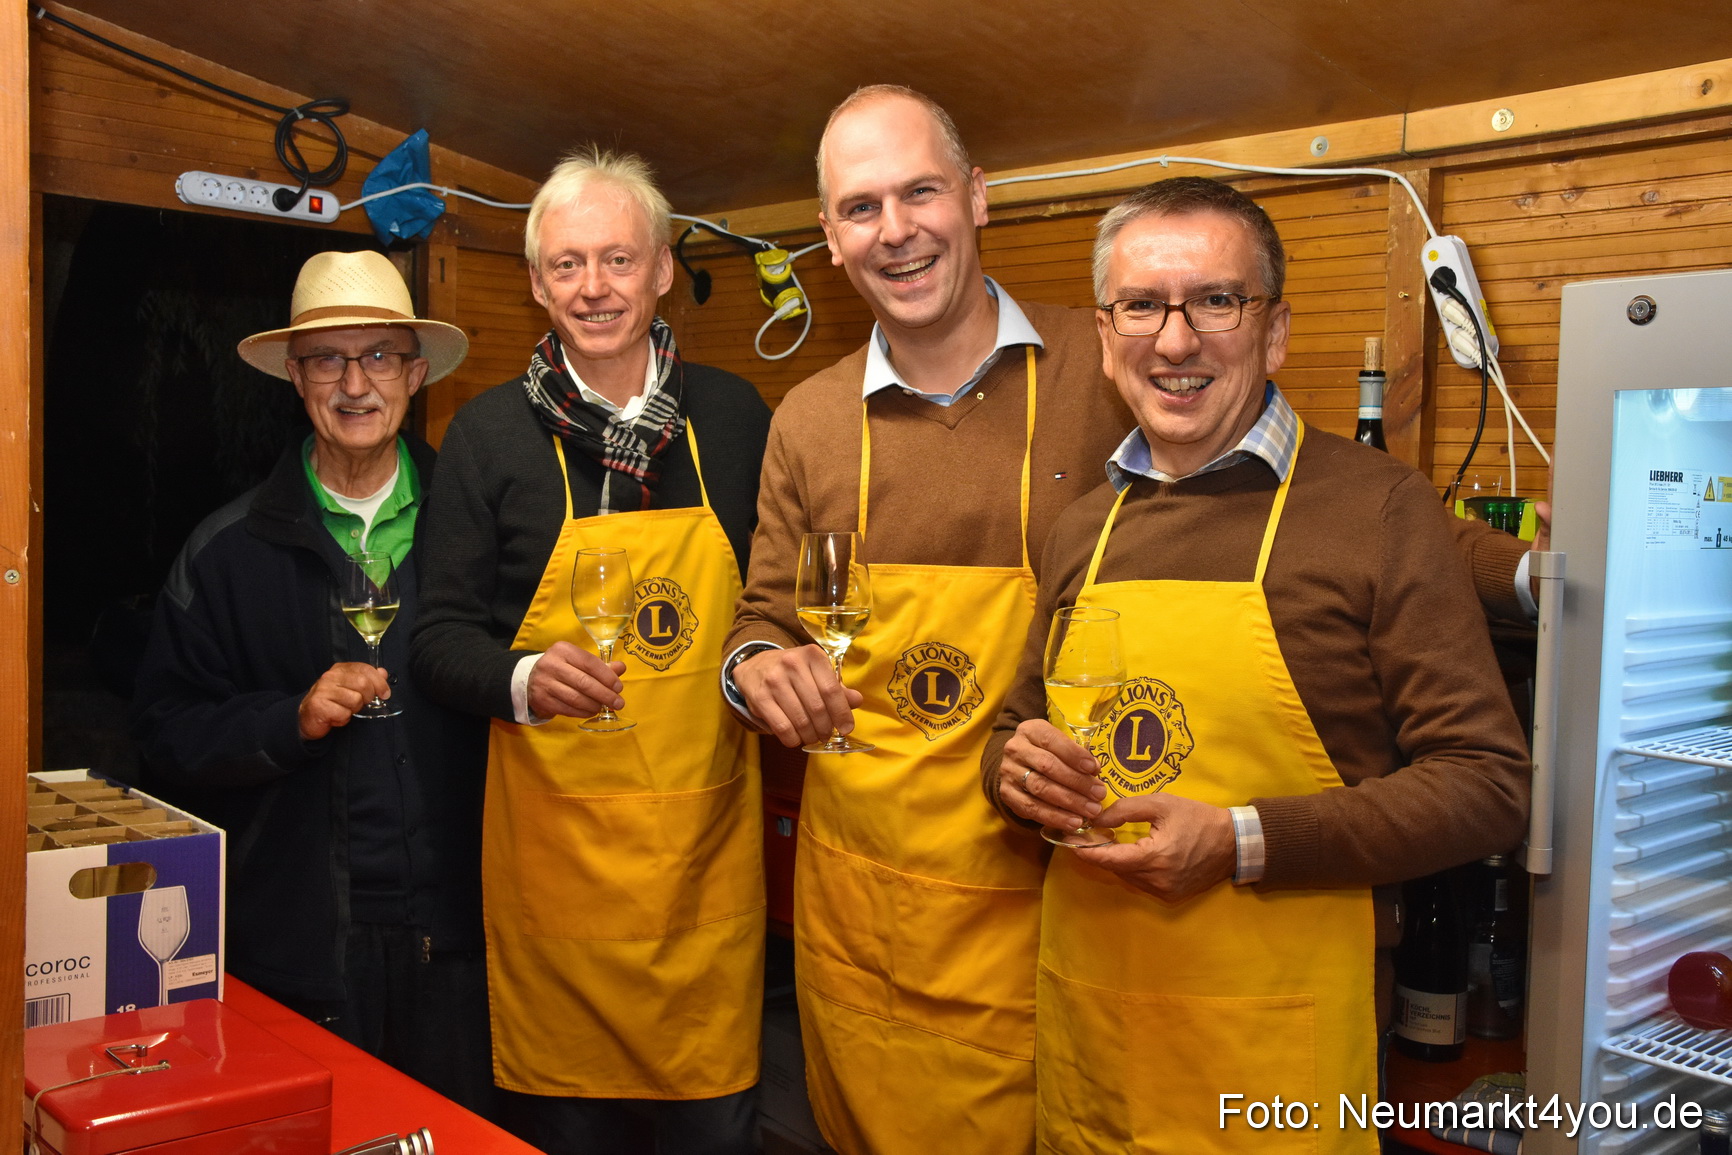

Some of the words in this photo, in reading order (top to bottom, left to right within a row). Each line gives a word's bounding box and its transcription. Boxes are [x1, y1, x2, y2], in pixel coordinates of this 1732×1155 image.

[1649, 470, 1684, 483] LIEBHERR
[635, 582, 677, 600] LIONS
[647, 605, 673, 638] L
[634, 642, 684, 660] INTERNATIONAL
[910, 647, 963, 667] LIONS
[923, 671, 951, 708] L
[1118, 684, 1168, 707] LIONS
[908, 709, 961, 730] INTERNATIONAL
[1126, 716, 1152, 761] L
[25, 955, 91, 977] coroc
[27, 972, 90, 986] ROFESSIONAL
